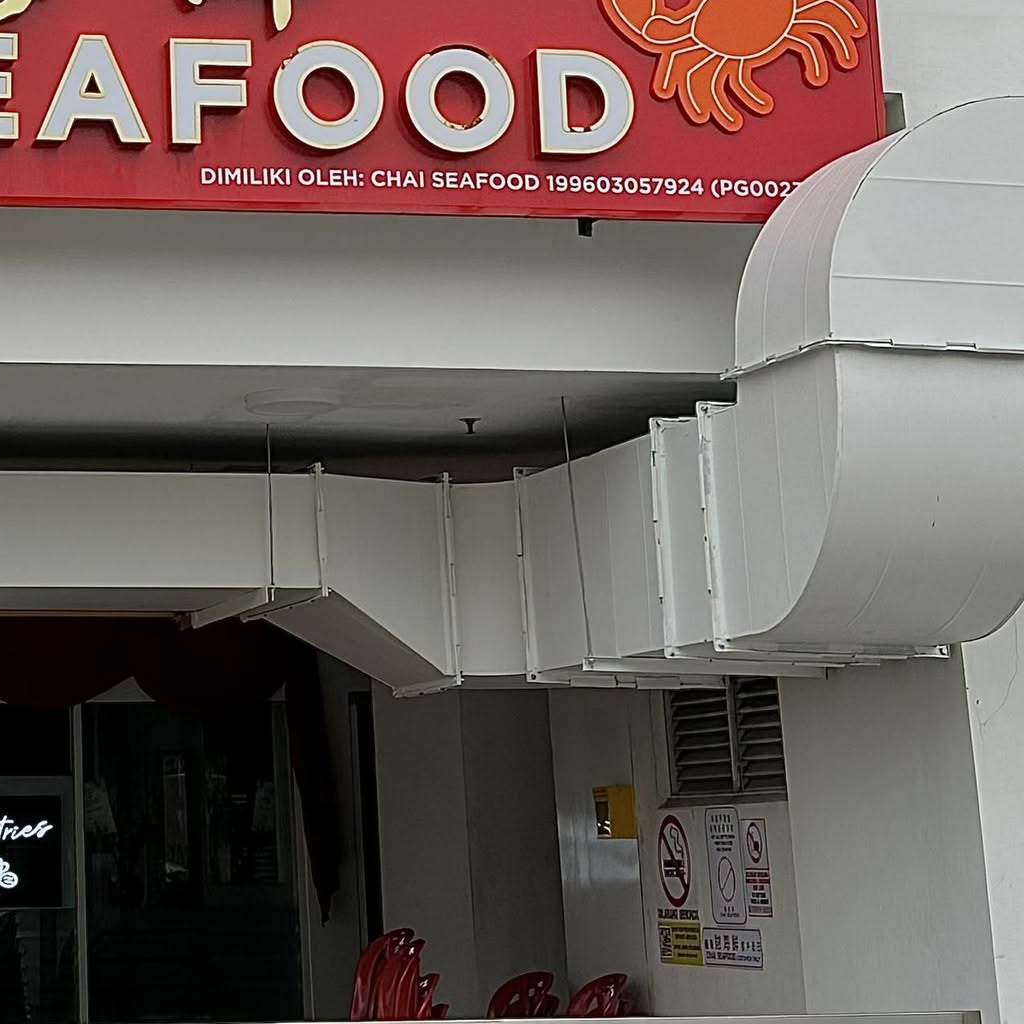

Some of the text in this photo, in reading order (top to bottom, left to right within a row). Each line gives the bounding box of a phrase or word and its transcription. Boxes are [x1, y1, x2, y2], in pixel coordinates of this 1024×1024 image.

[200, 167, 291, 185] DIMILIKI
[298, 169, 365, 187] OLEH:
[371, 170, 425, 188] CHAI
[431, 172, 540, 191] SEAFOOD
[546, 175, 704, 195] 199603057924
